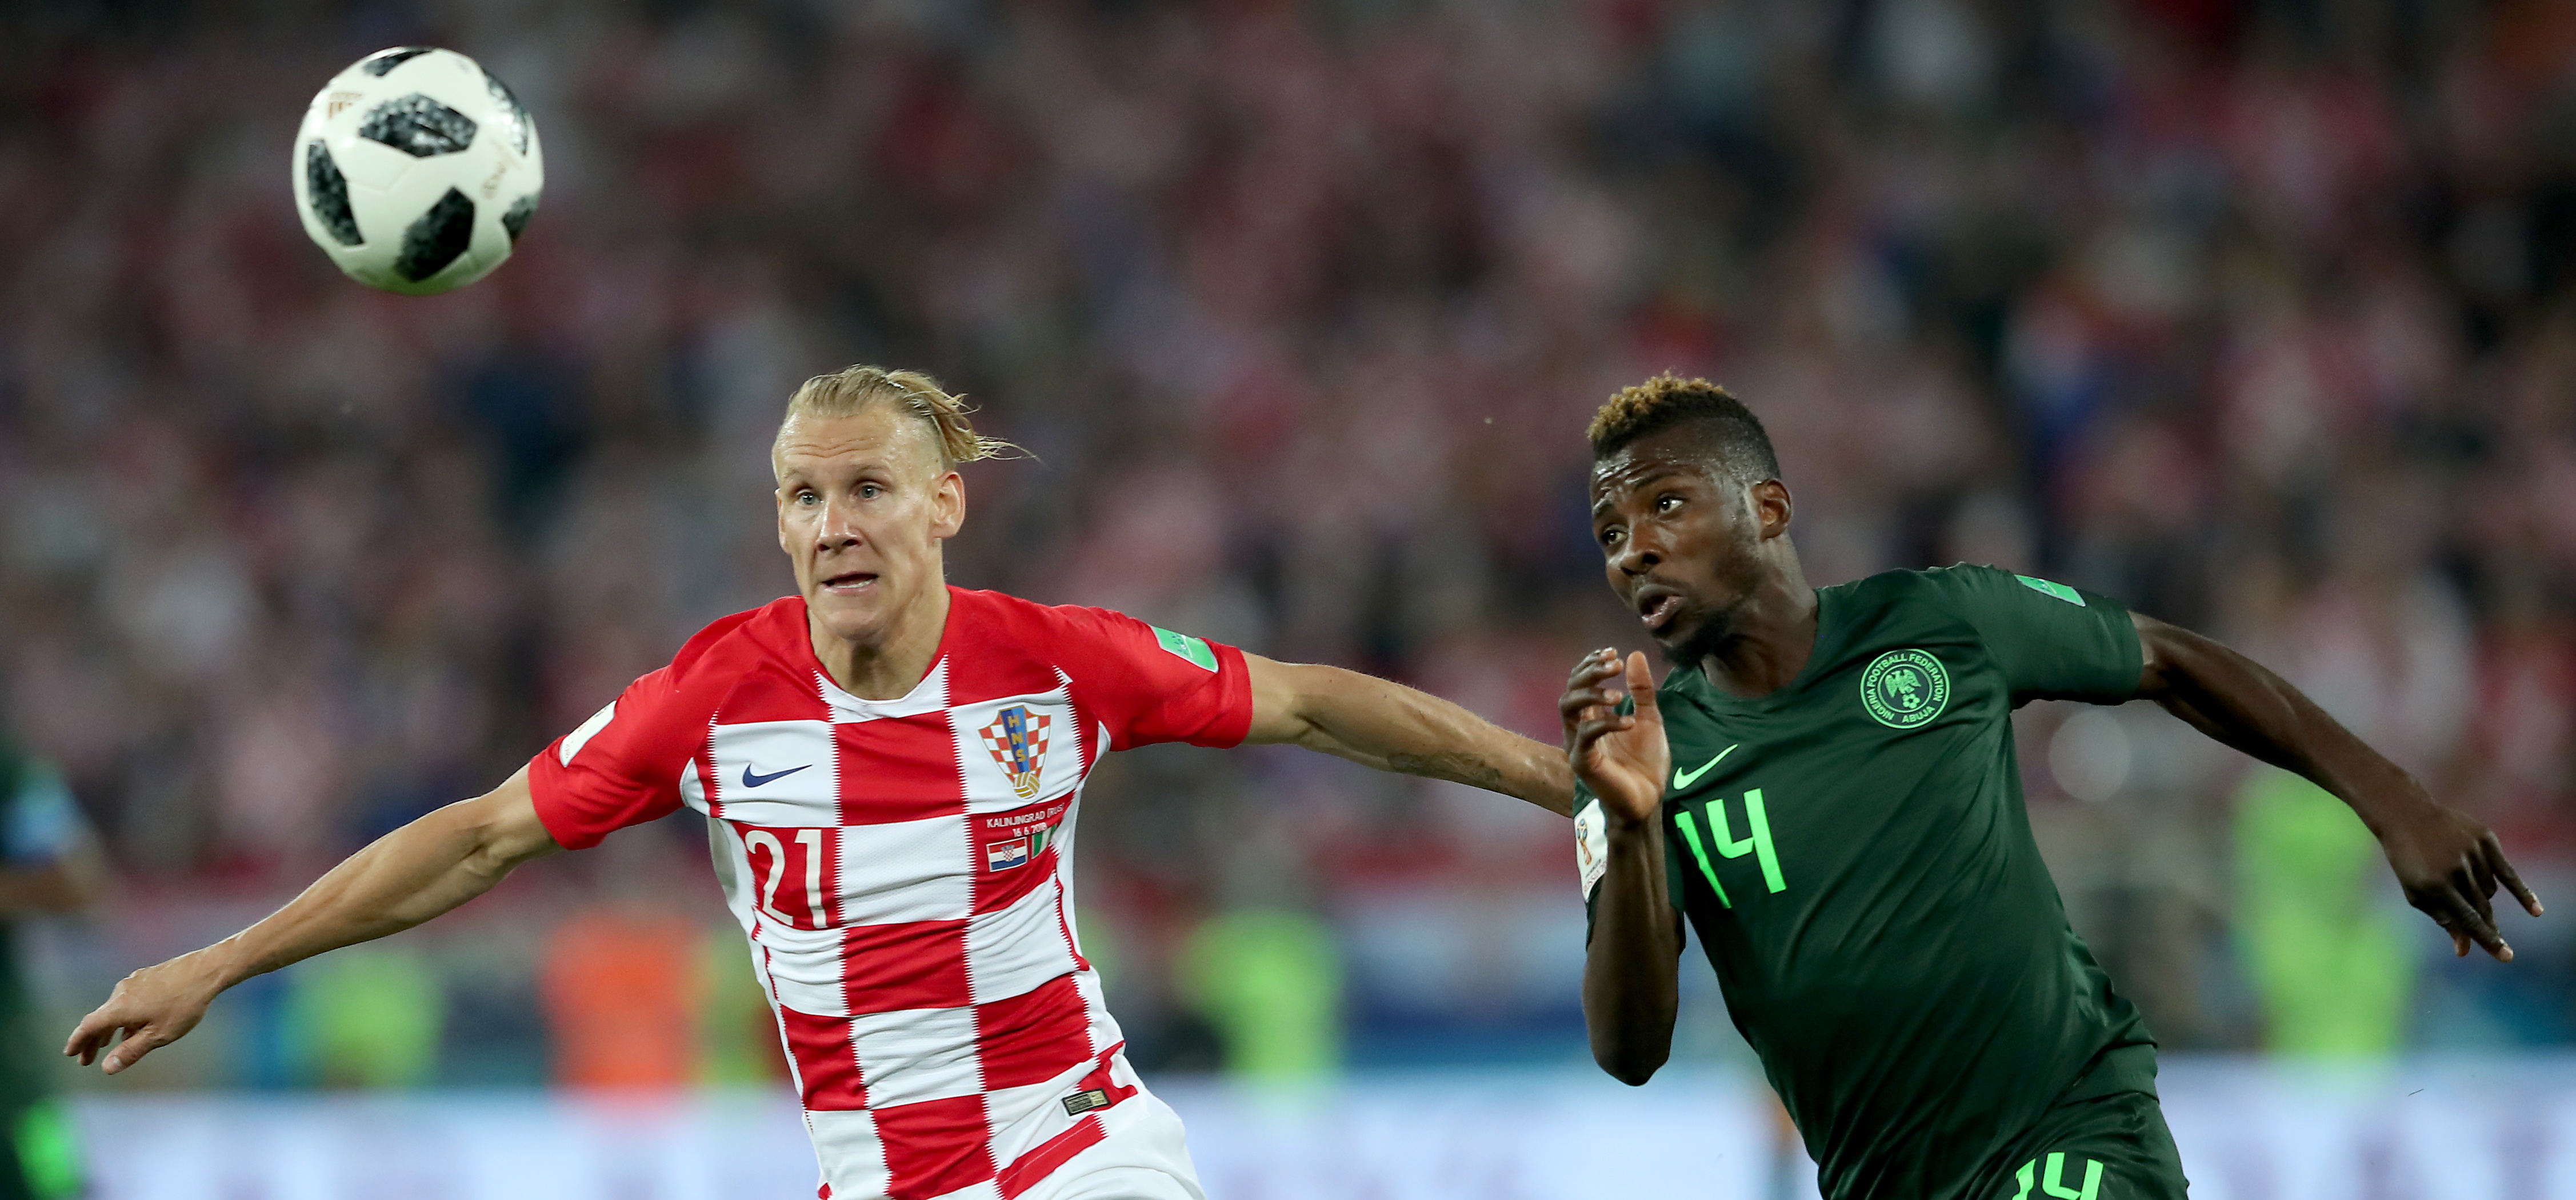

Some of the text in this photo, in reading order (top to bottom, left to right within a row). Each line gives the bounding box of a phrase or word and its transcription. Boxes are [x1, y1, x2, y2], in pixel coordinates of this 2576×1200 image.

[1866, 653, 1944, 721] NIGERIA FOOTBALL FEDERATION
[1901, 706, 1936, 723] ABUJA
[1007, 714, 1027, 763] HNS
[1674, 787, 1788, 909] 14
[745, 829, 829, 929] 21
[2011, 1151, 2104, 1200] 14
